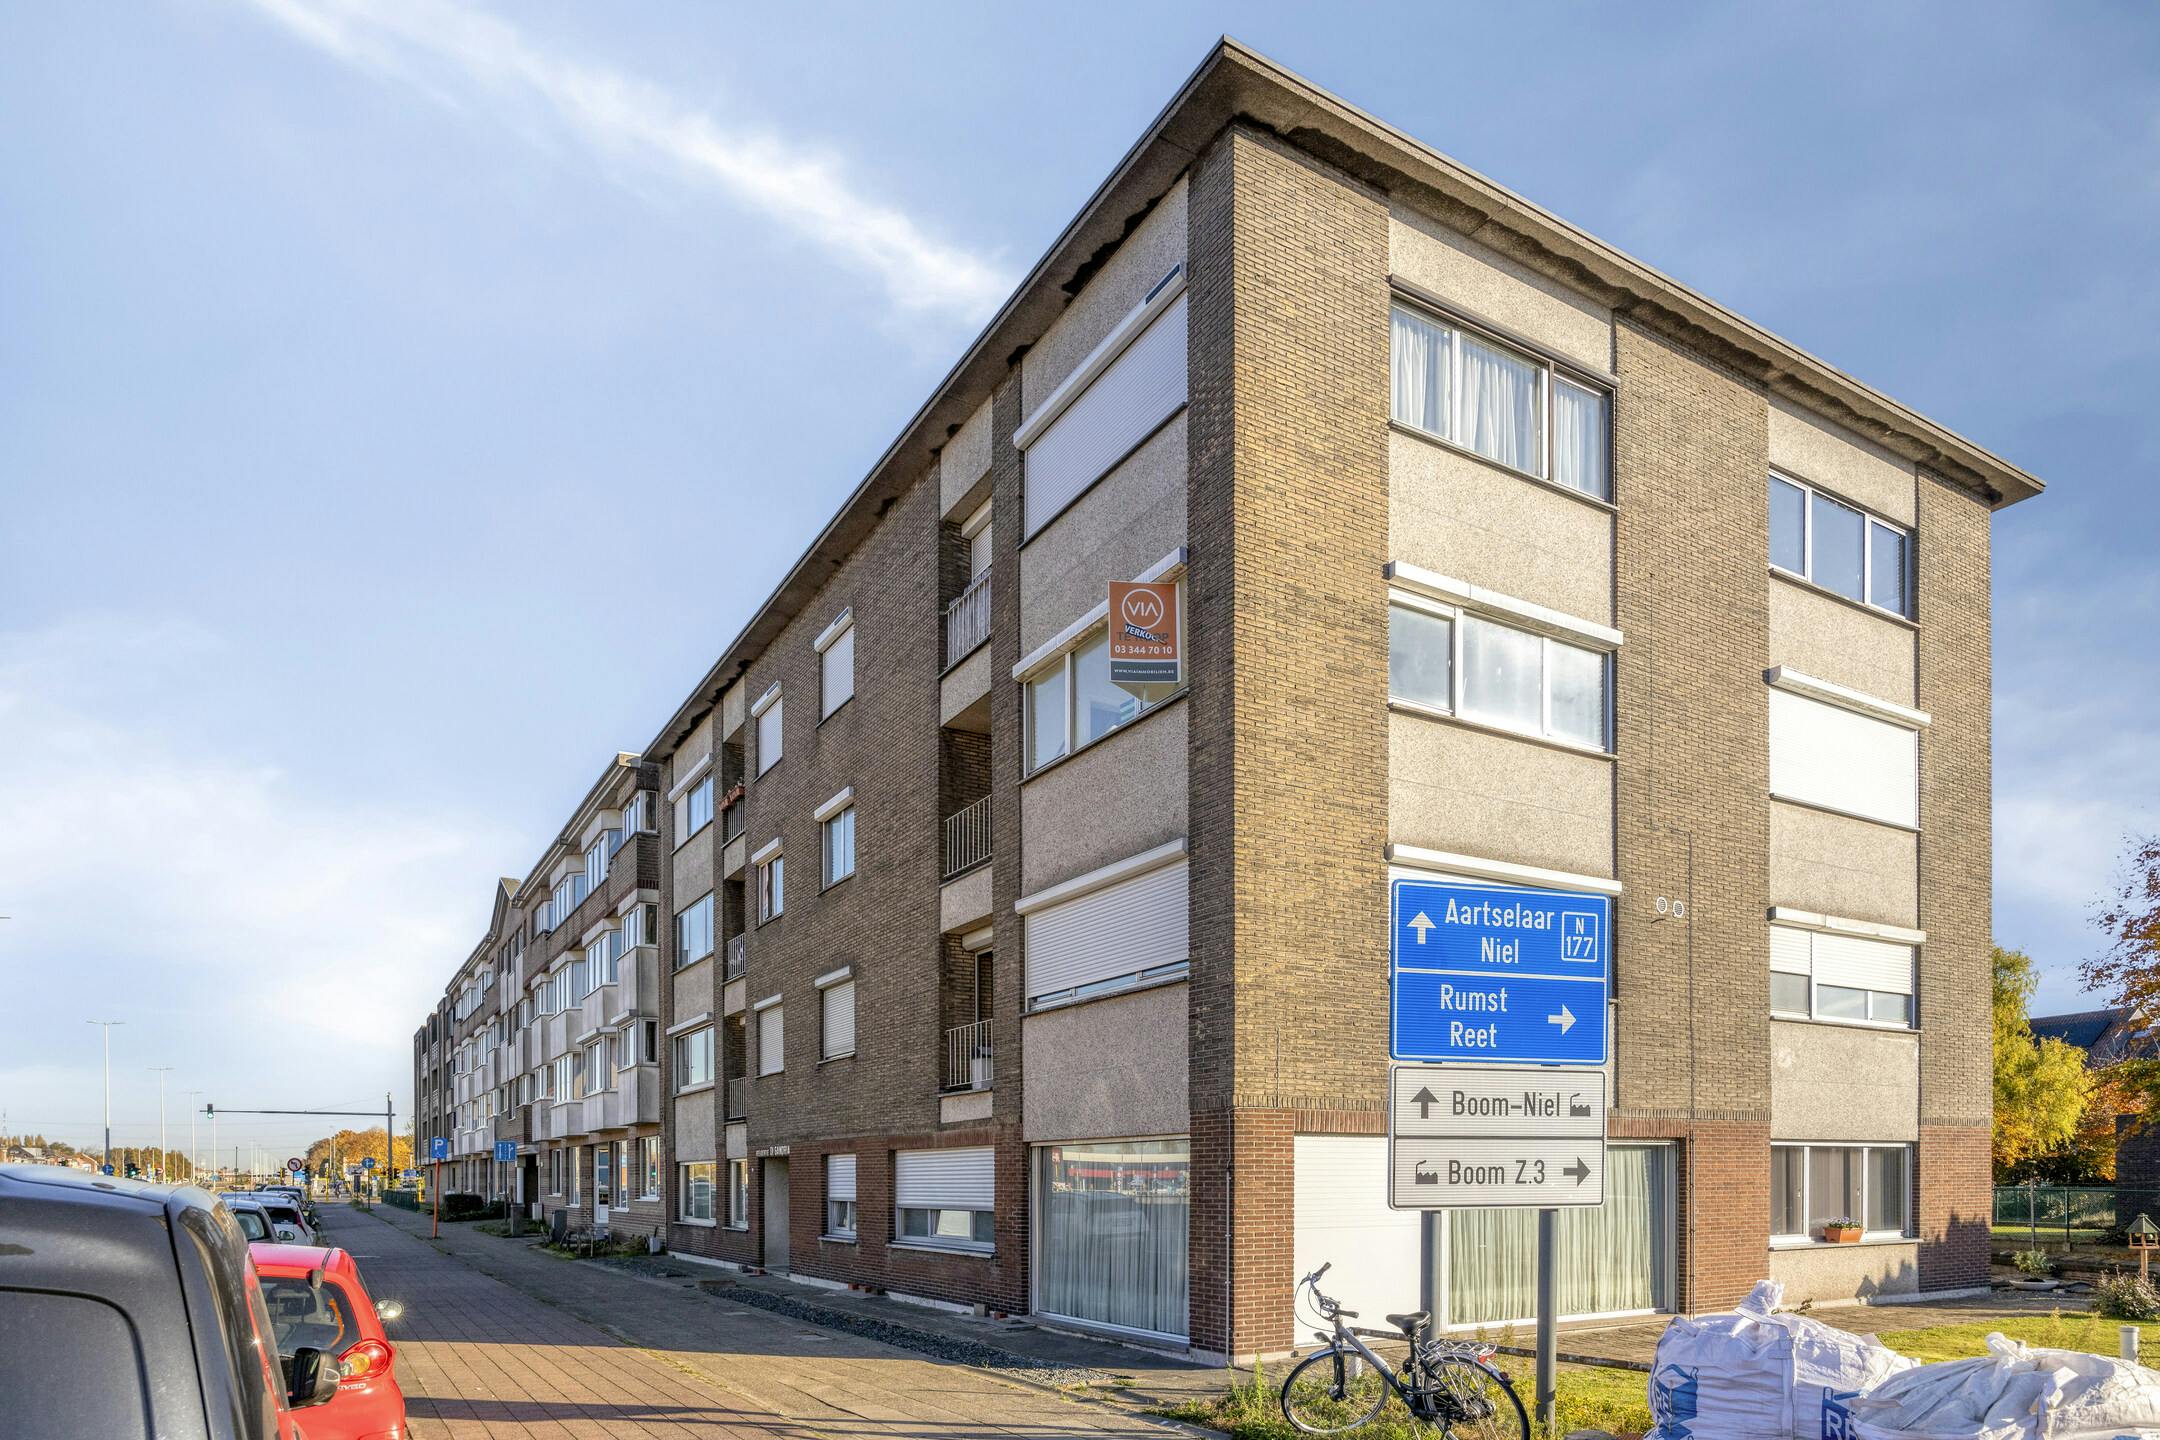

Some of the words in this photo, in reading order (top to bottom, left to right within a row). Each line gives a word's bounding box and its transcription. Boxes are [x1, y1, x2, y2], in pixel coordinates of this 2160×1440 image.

[1127, 601, 1158, 617] VIA
[1114, 645, 1126, 654] 03
[1128, 646, 1146, 654] 344
[1148, 646, 1160, 655] 70
[1162, 646, 1173, 655] 10
[1444, 898, 1555, 930] Aartselaar
[1575, 917, 1585, 934] N
[1481, 937, 1519, 964] Niel
[1566, 936, 1594, 958] 177
[1440, 984, 1508, 1012] Rumst
[1450, 1021, 1497, 1048] Reet
[1452, 1090, 1560, 1117] Boom-Niel
[434, 1139, 444, 1151] P
[1449, 1159, 1505, 1185] Boom
[1515, 1159, 1545, 1185] Z.3
